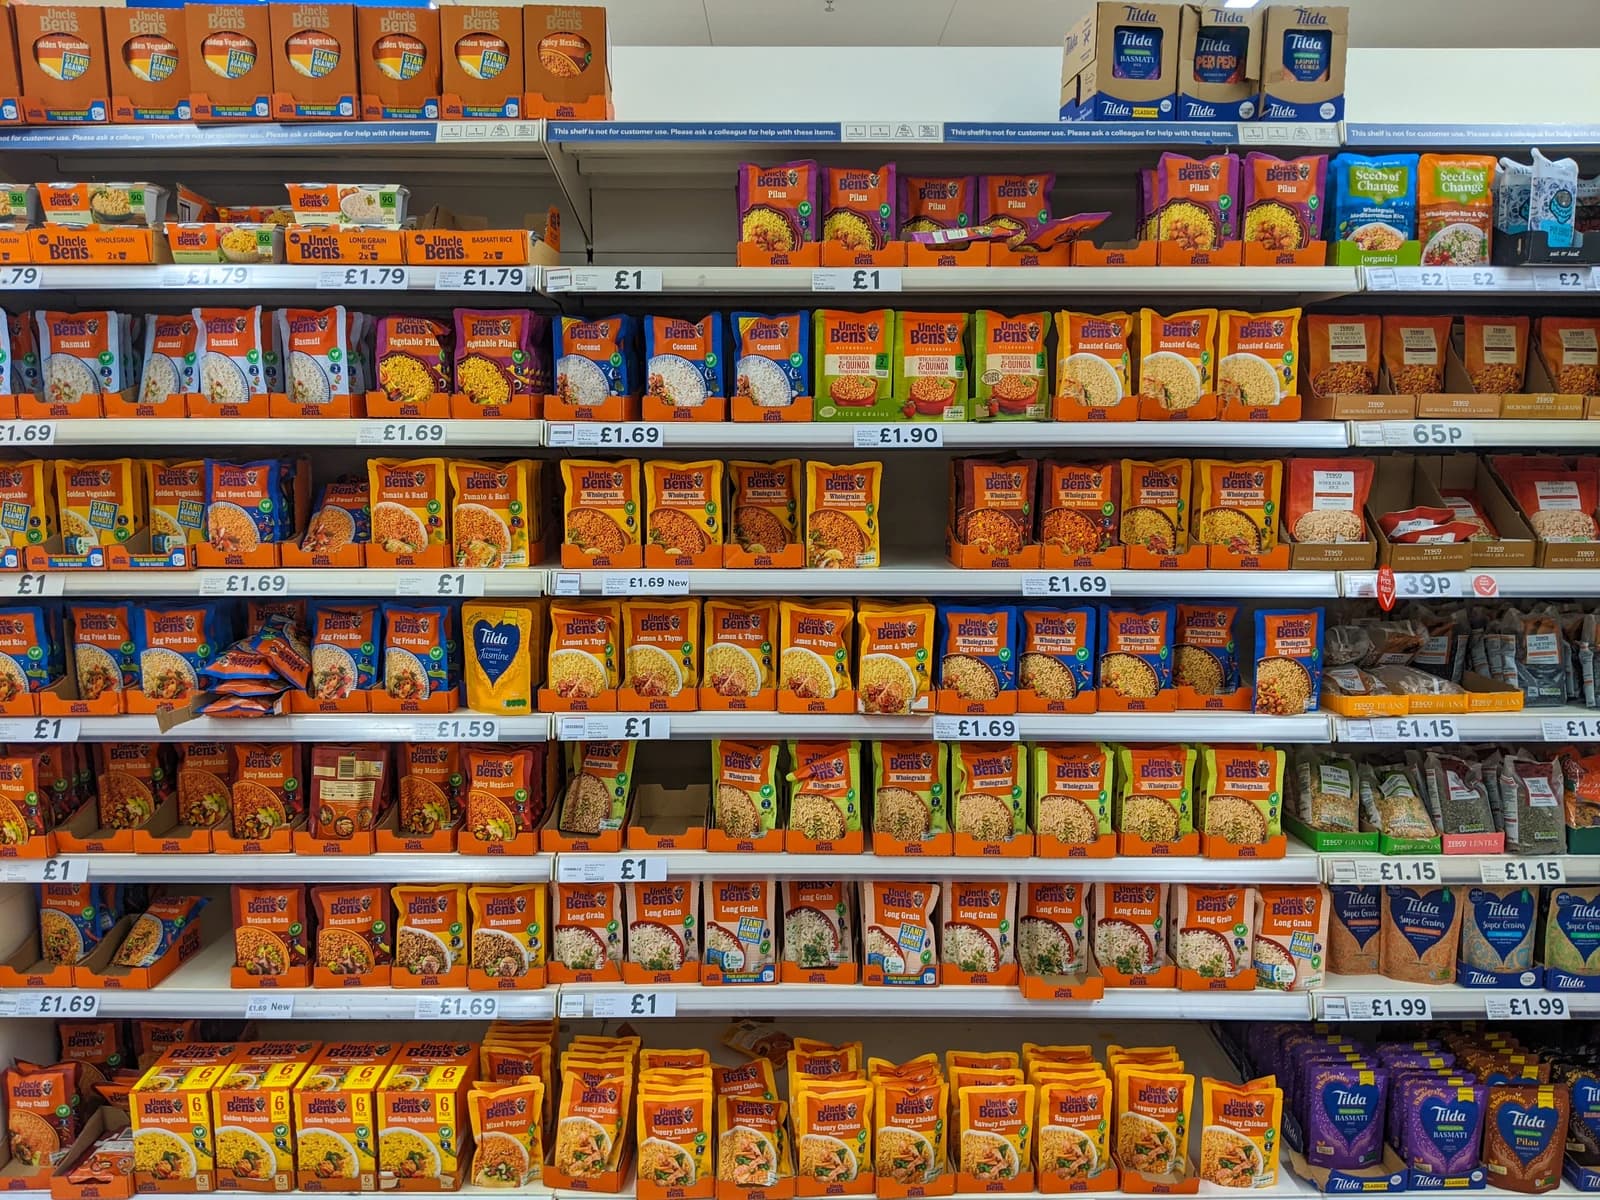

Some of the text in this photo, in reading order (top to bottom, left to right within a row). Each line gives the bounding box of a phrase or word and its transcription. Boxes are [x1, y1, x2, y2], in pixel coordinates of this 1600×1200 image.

[1119, 31, 1153, 47] Tilda
[1200, 39, 1231, 52] Tilda
[1288, 34, 1322, 50] Tilda
[1120, 55, 1154, 63] BASMATI
[1196, 56, 1235, 69] PERI PERI
[1102, 100, 1131, 116] Tilda
[714, 129, 747, 137] colleague
[760, 129, 775, 137] help
[1356, 171, 1402, 180] Seeds of
[1190, 184, 1209, 192] Pilau
[1358, 181, 1399, 193] Change
[383, 195, 392, 203] 90
[850, 193, 867, 201] Pilau
[0, 268, 37, 284] .79
[187, 268, 247, 284] £1.79
[345, 269, 405, 284] £1.79
[464, 269, 523, 285] £1.79
[615, 271, 642, 289] £1
[853, 271, 880, 289] £1
[1421, 273, 1442, 286] £2
[1473, 273, 1494, 286] £2
[1560, 273, 1580, 286] £2
[390, 338, 423, 346] Vegetable
[673, 343, 697, 351] Coconut
[1237, 342, 1284, 350] Roasted Garlic
[846, 361, 870, 369] QUINOA
[384, 425, 443, 440] £1.69
[601, 427, 659, 443] £1.69
[880, 427, 938, 443] £1.90
[1413, 425, 1461, 444] 65p
[87, 490, 115, 498] Vegetable
[93, 502, 114, 512] STAND
[18, 575, 45, 594] £1
[226, 576, 285, 591] £1.69
[437, 575, 465, 594] £1
[630, 578, 665, 587] £1.69
[1049, 576, 1106, 592] £1.69
[1404, 575, 1450, 594] 39p
[152, 637, 163, 645] Egg
[183, 636, 197, 644] Rice
[480, 628, 507, 645] Tilda
[478, 650, 508, 661] Jasmine
[34, 719, 61, 738] £1
[437, 722, 494, 738] £1.59
[625, 718, 652, 738] £1
[958, 720, 1015, 736] £1.69
[1397, 721, 1454, 737] £1.15
[474, 780, 488, 788] Spicy
[43, 861, 69, 880] £1
[621, 859, 646, 879] £1
[1380, 863, 1435, 880] £1.15
[1505, 863, 1560, 880] £1.15
[1405, 897, 1440, 915] Tilda
[1484, 901, 1519, 918] Tilda
[490, 918, 521, 926] Mushroom
[1274, 919, 1312, 928] Long Grain
[1399, 915, 1444, 929] Super Grains
[1483, 921, 1525, 932] Super Grains
[1470, 972, 1497, 984] Tilda
[1557, 974, 1584, 988] Tilda
[40, 996, 96, 1013] £1.69
[271, 1002, 290, 1010] New
[440, 998, 495, 1015] £1.69
[631, 994, 656, 1014] £1
[1372, 999, 1426, 1016] £1.99
[1510, 998, 1564, 1016] £1.99
[17, 1099, 49, 1108] Spicy Chilli
[192, 1096, 200, 1112] 6
[1332, 1090, 1366, 1106] Tilda
[1335, 1114, 1368, 1122] BASMATI
[1431, 1106, 1466, 1122] Tilda
[1508, 1110, 1545, 1129] Tilda
[486, 1119, 526, 1129] Mixed Pepper
[813, 1124, 836, 1132] Savoury
[1433, 1131, 1467, 1139] BASMATI
[1516, 1137, 1539, 1147] Pilau
[1333, 1178, 1360, 1190] Tilda
